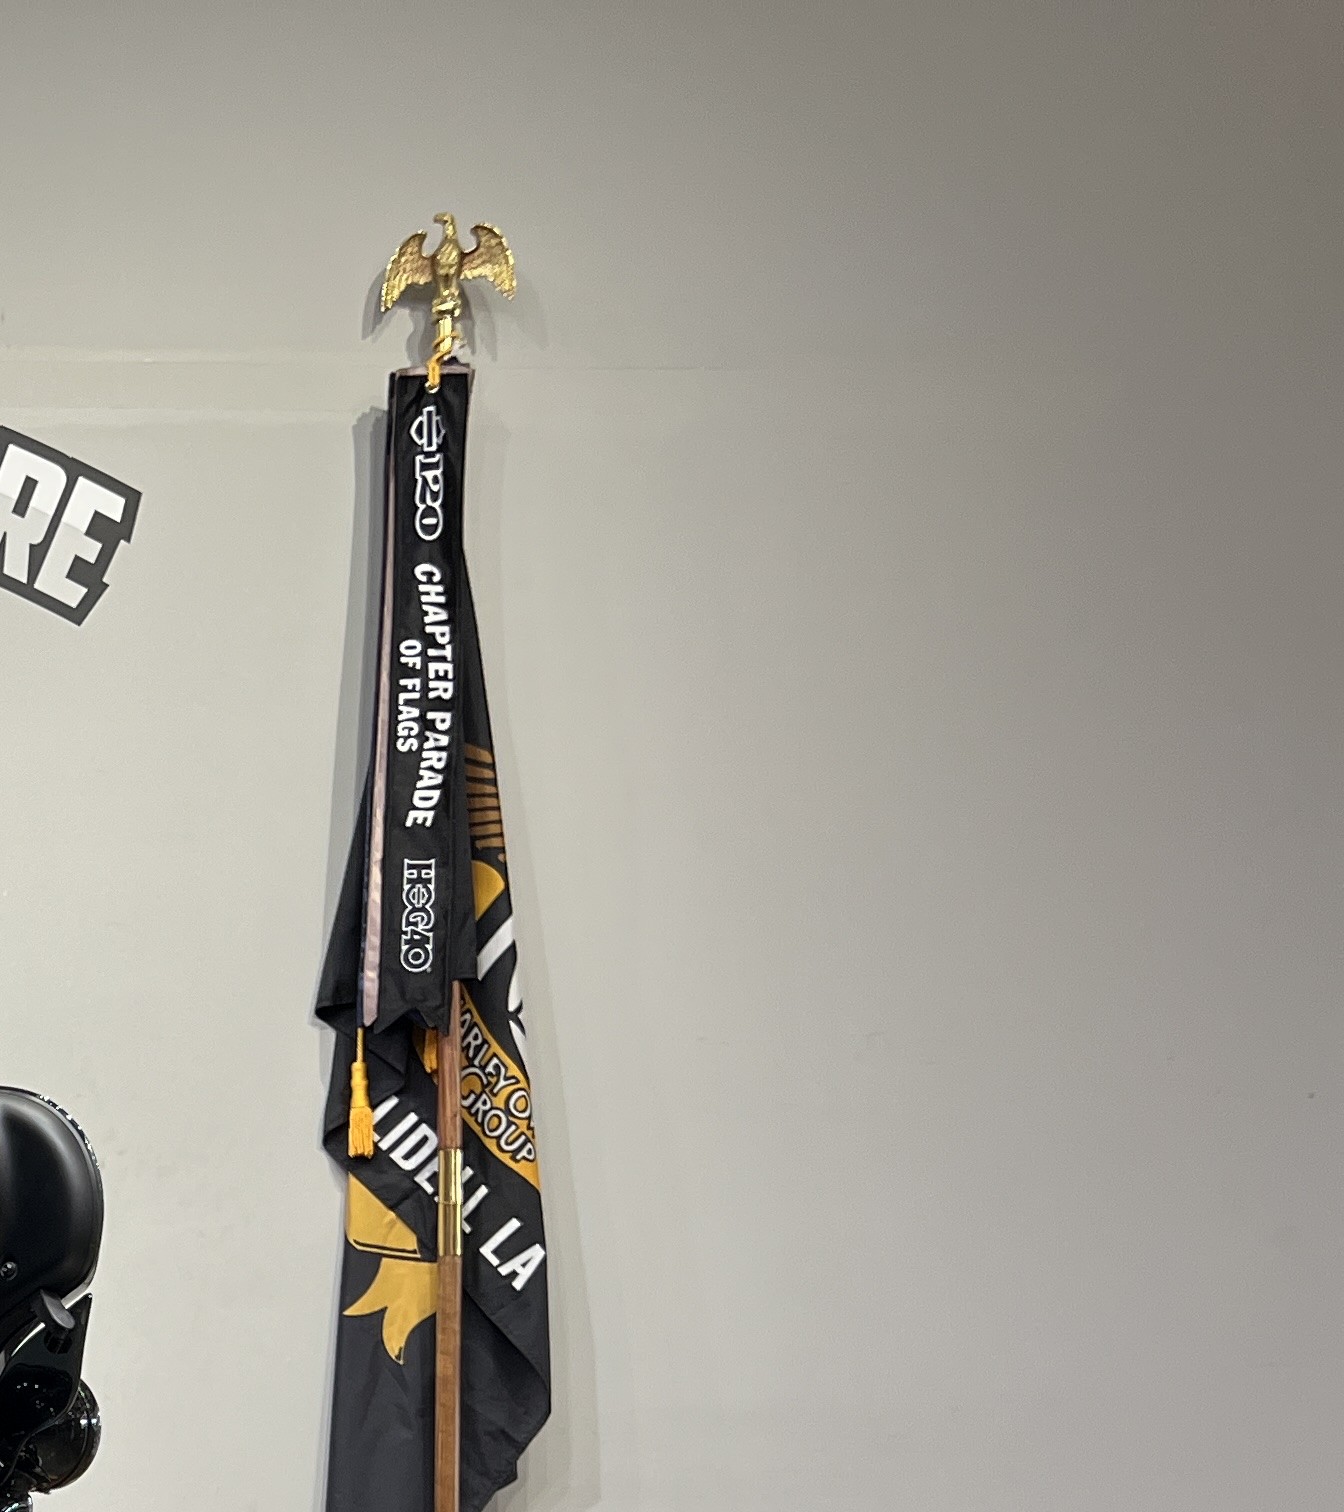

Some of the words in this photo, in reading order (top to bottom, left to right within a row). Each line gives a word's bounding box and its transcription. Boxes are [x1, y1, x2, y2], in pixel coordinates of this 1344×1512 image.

[399, 638, 422, 670] OF
[413, 563, 454, 700] CHAPTER
[395, 678, 421, 753] FLAGS
[405, 711, 452, 828] PARADE
[460, 1066, 537, 1163] GROUP
[478, 1217, 546, 1292] LA
